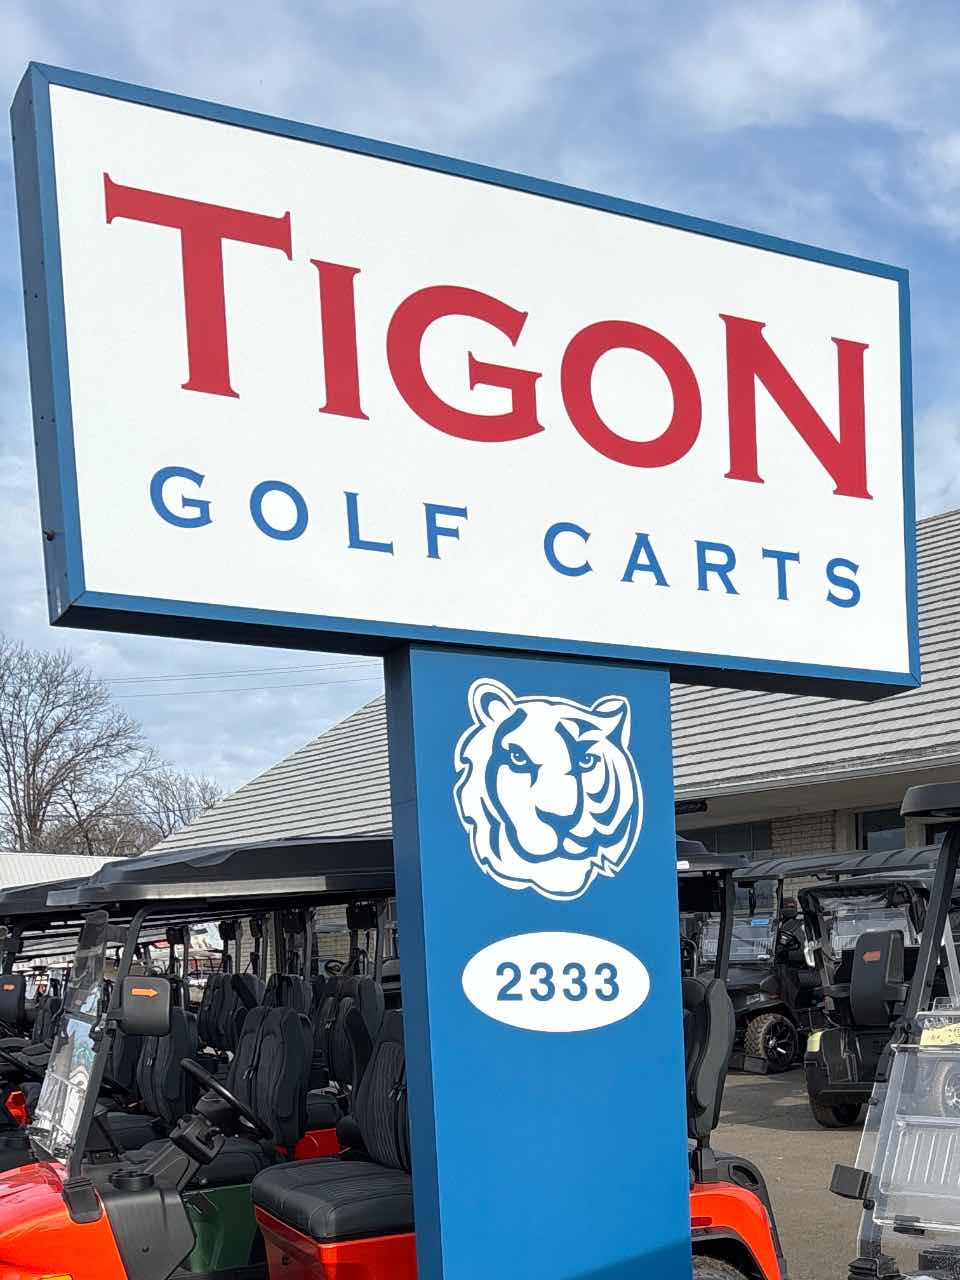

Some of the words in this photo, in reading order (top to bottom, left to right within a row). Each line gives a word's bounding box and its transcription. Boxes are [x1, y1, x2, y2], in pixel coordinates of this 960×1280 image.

[104, 172, 873, 500] TIGON
[150, 466, 468, 560] GOLF
[543, 522, 861, 608] CARTS
[495, 961, 620, 1002] 2333
